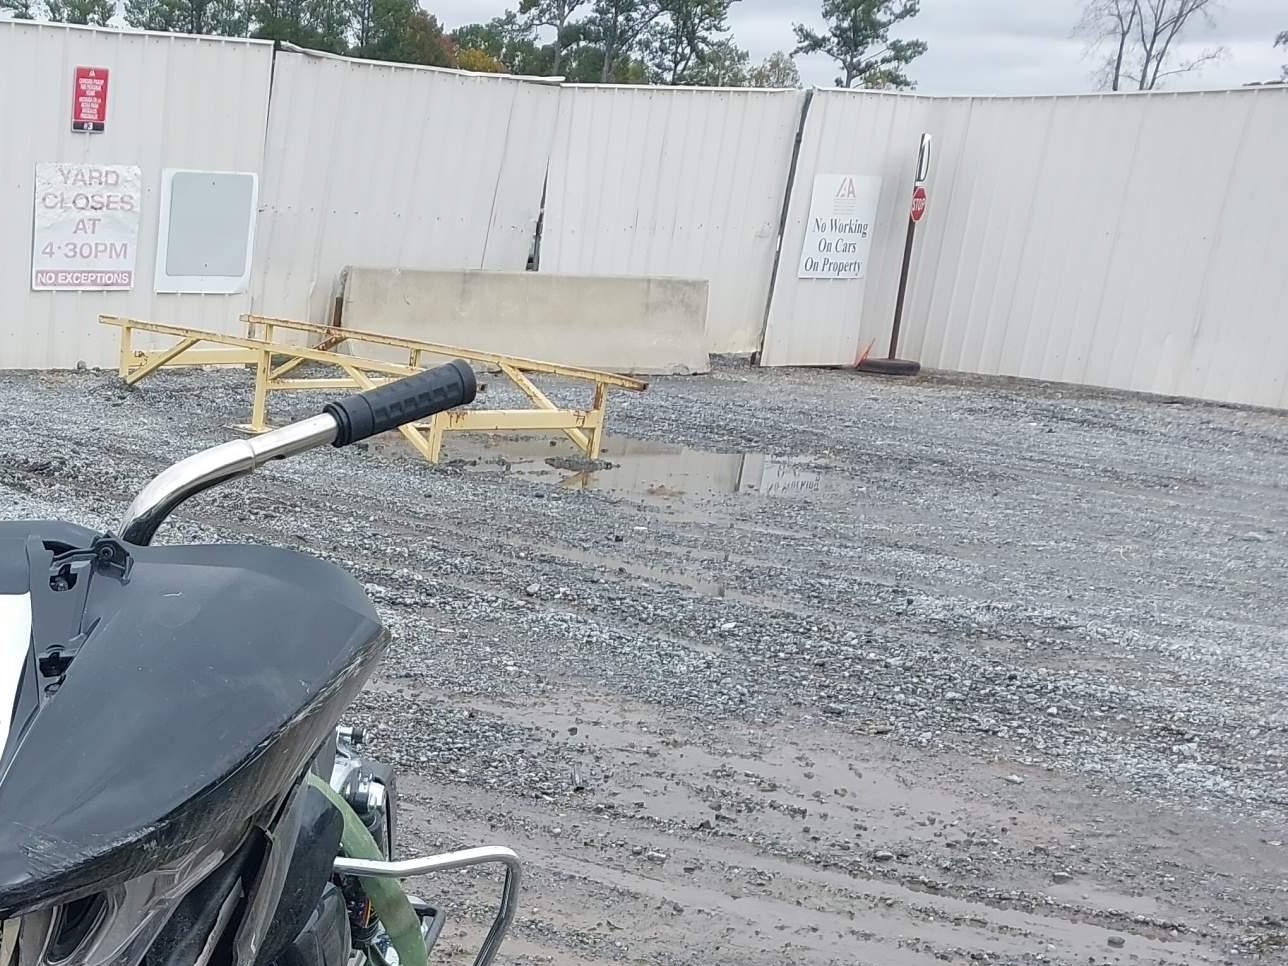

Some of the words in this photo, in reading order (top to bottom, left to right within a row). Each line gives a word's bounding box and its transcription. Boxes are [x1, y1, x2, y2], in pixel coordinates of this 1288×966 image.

[58, 167, 120, 187] YARD
[41, 192, 135, 212] CLOSES
[912, 198, 925, 211] STOP
[72, 218, 102, 235] AT
[813, 218, 827, 234] No
[830, 219, 869, 238] Working
[818, 238, 832, 253] On
[835, 238, 857, 254] Cars
[804, 257, 820, 272] On
[822, 258, 863, 277] Property
[37, 272, 56, 285] NO
[58, 272, 130, 286] EXCEPTIONS
